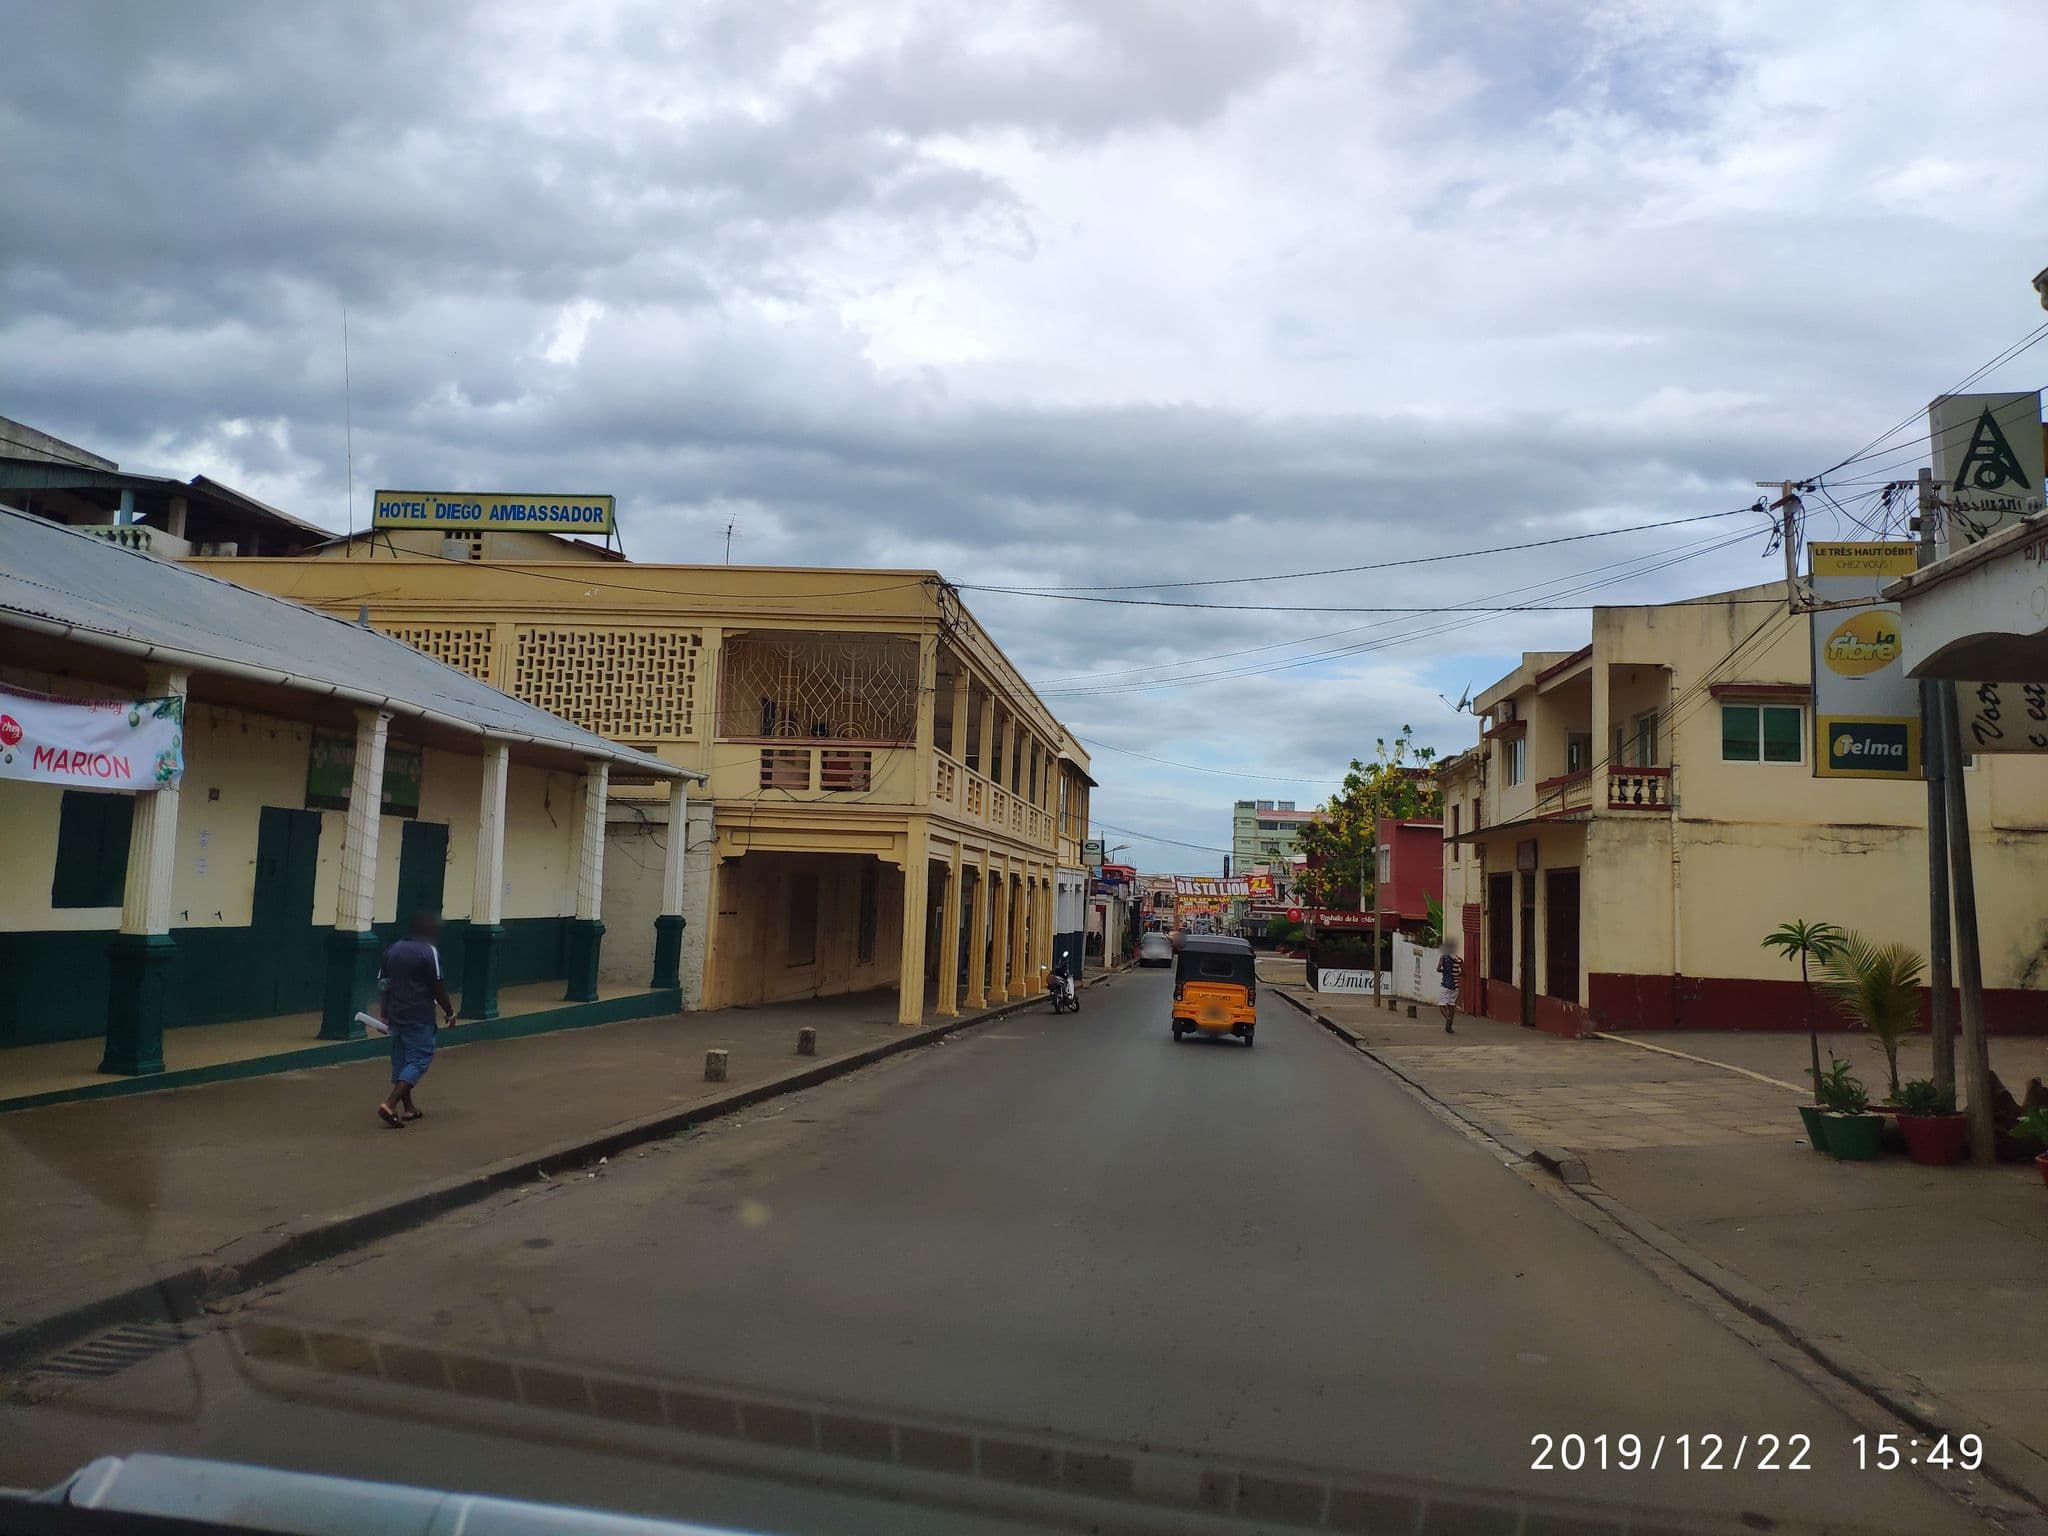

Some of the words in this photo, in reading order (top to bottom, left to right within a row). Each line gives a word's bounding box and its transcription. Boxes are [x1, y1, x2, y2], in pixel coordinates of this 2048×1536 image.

[379, 502, 427, 519] HOTEL
[435, 502, 482, 520] DIEGO
[489, 504, 604, 523] AMBASSADOR
[1815, 548, 1827, 556] LE
[1828, 547, 1852, 556] TRÈS
[1855, 547, 1883, 556] HAUT
[1884, 546, 1914, 556] DÉBIT
[1836, 560, 1861, 569] CHEZ
[1864, 560, 1888, 569] VOUS
[1828, 631, 1896, 661] fibre
[1876, 631, 1896, 645] La
[1839, 737, 1904, 756] Telma
[32, 744, 131, 779] MARION
[1176, 881, 1218, 896] BASTA
[1220, 882, 1249, 896] LION
